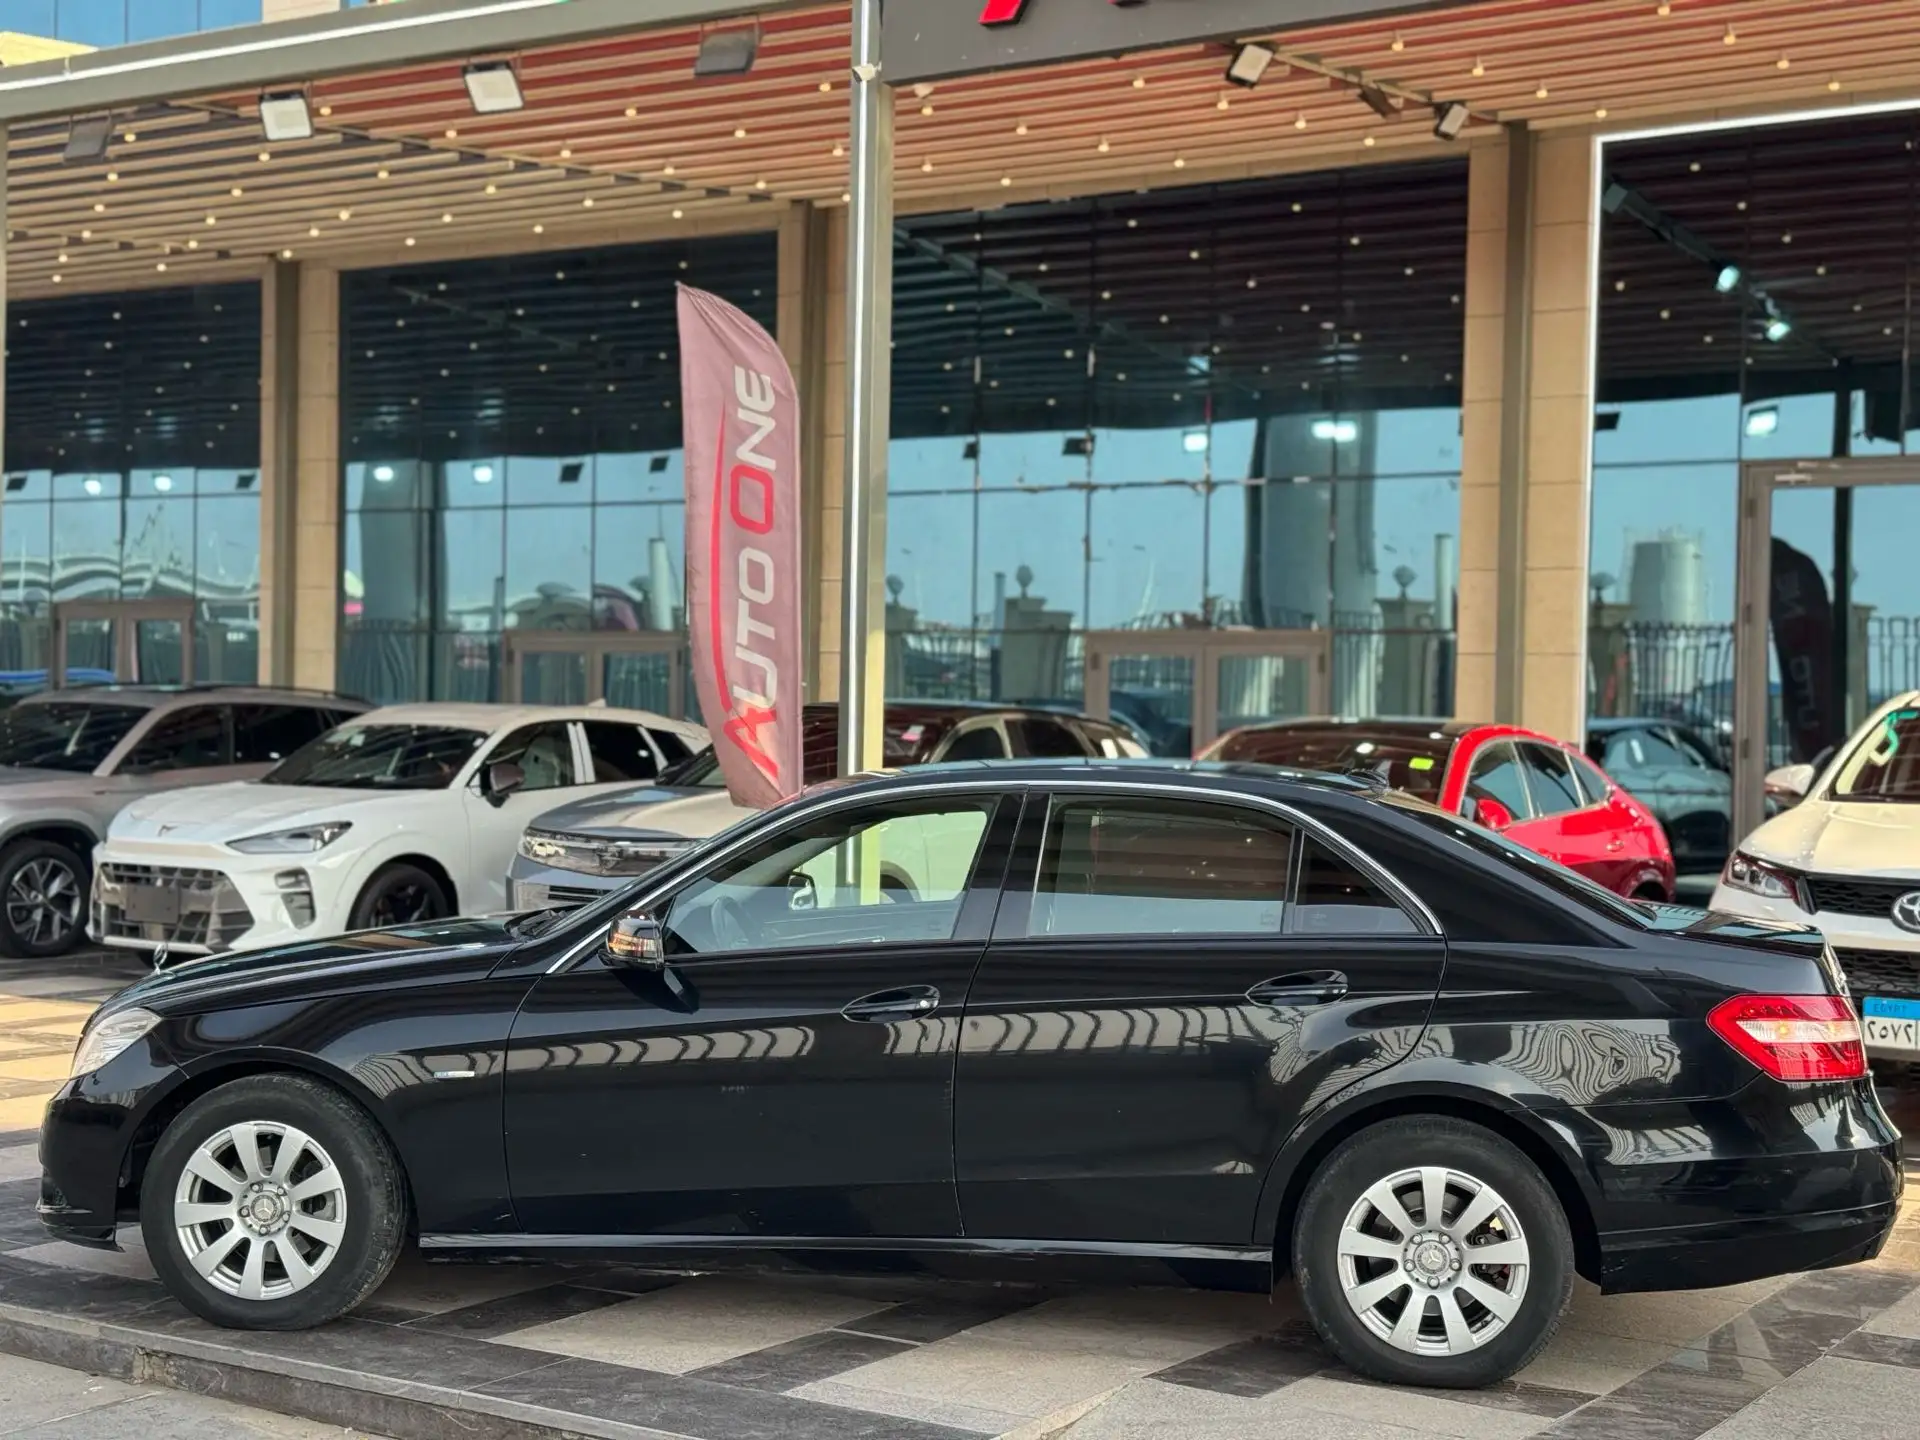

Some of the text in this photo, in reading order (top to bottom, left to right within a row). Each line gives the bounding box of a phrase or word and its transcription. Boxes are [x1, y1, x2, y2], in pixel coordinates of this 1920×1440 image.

[723, 366, 778, 781] AUTO ONE
[1874, 1003, 1906, 1014] EGYPT
